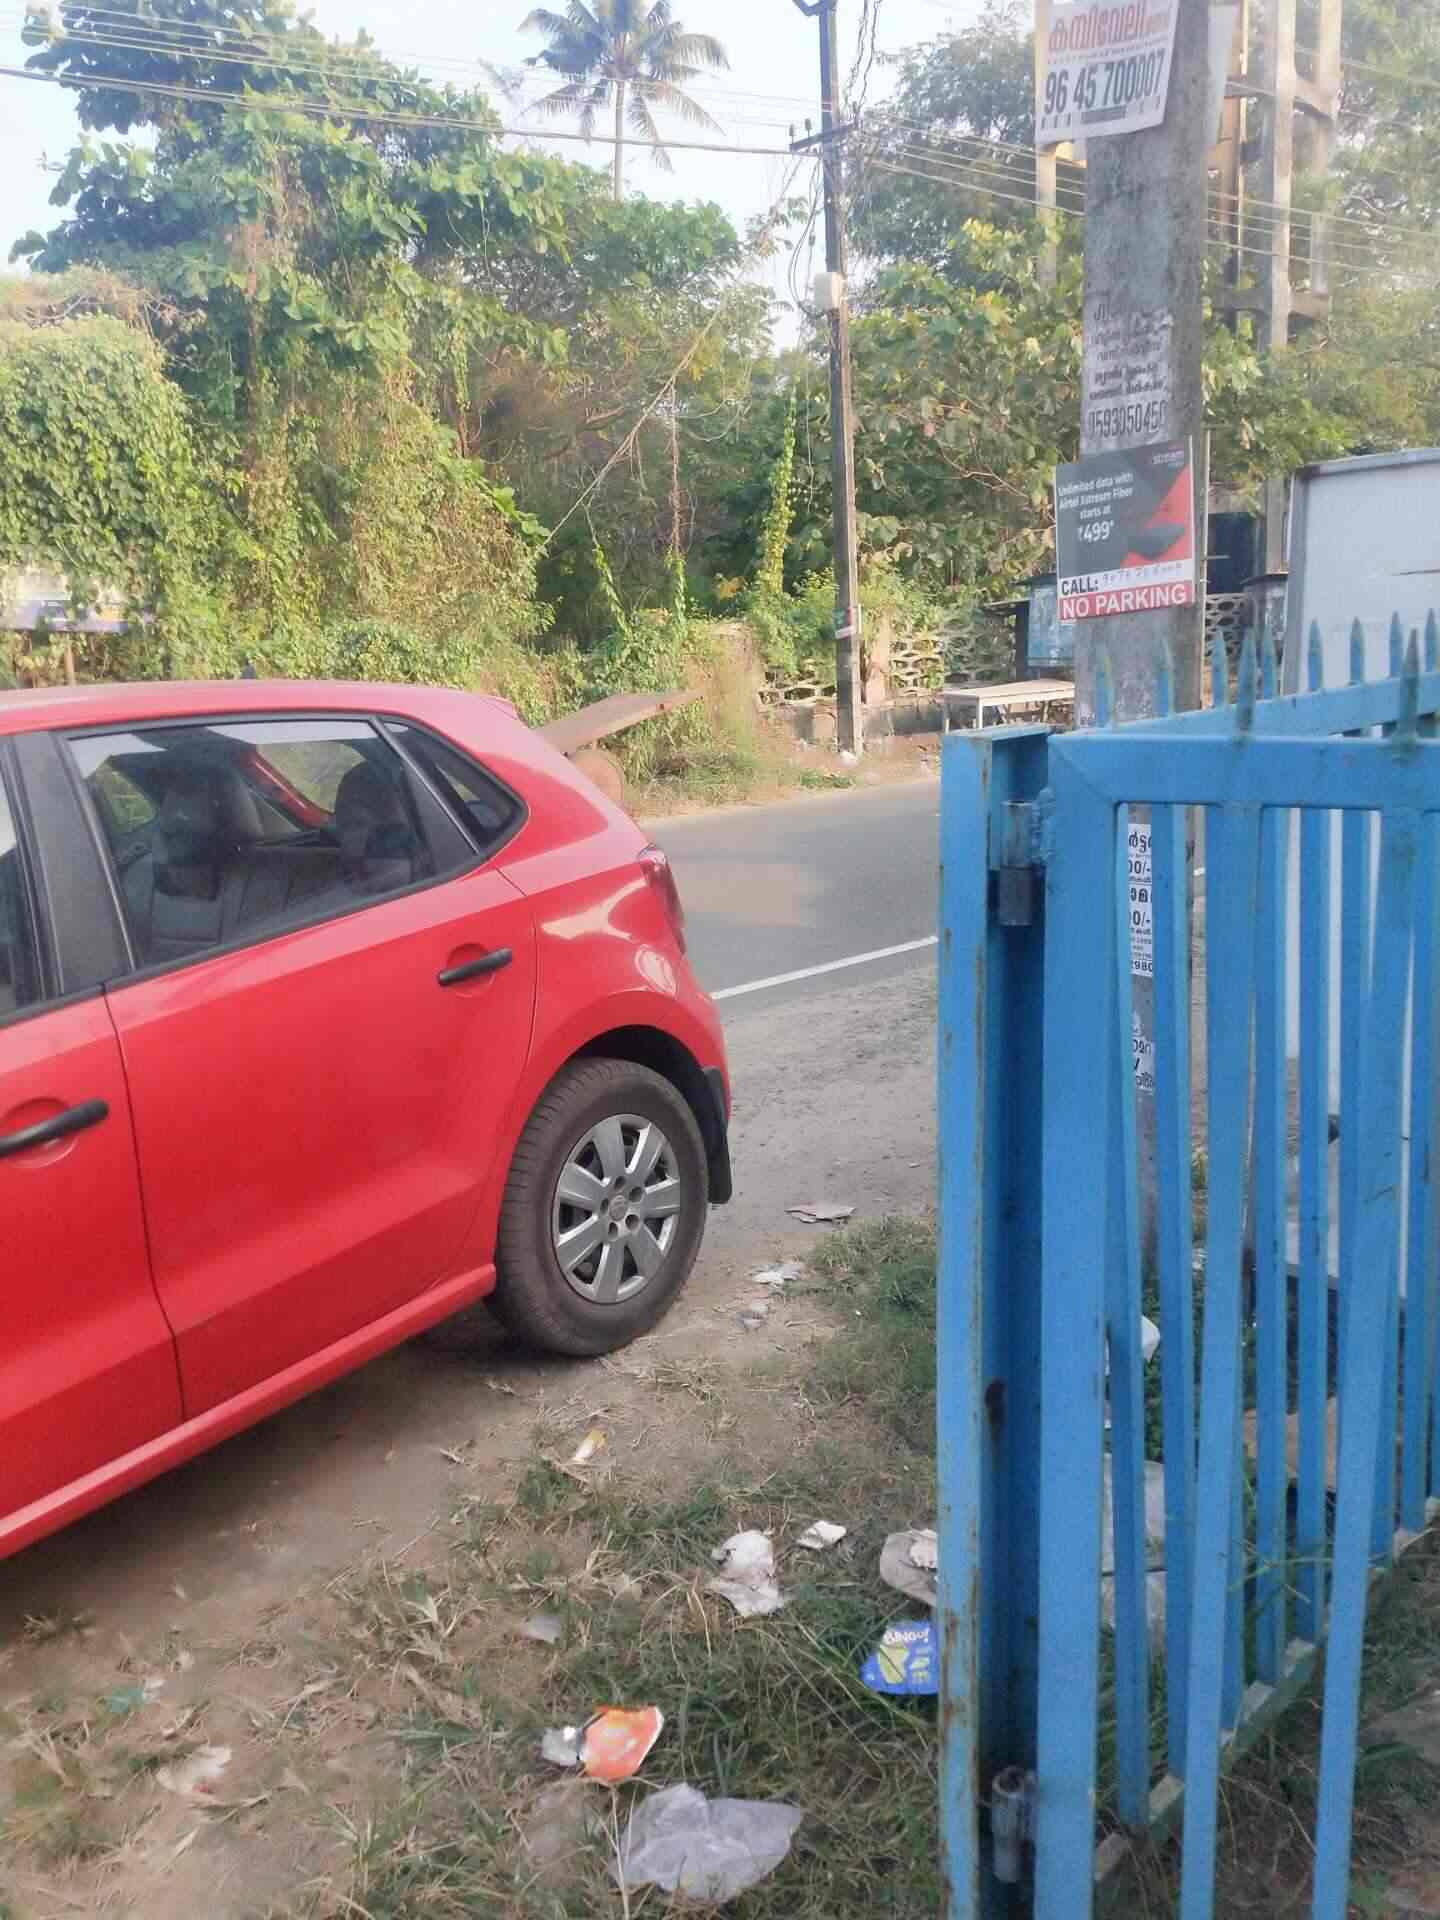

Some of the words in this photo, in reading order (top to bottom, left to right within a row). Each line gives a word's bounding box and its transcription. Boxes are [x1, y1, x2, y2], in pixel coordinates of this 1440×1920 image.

[1044, 69, 1068, 115] 96
[1073, 66, 1098, 110] 45
[1102, 48, 1165, 106] 700007
[1095, 476, 1114, 490] data
[1114, 472, 1134, 485] with
[1112, 486, 1134, 499] Fiber
[1079, 507, 1102, 520] starts
[1061, 575, 1099, 597] CALL:
[1062, 598, 1089, 619] NO
[1095, 583, 1187, 616] PARKING
